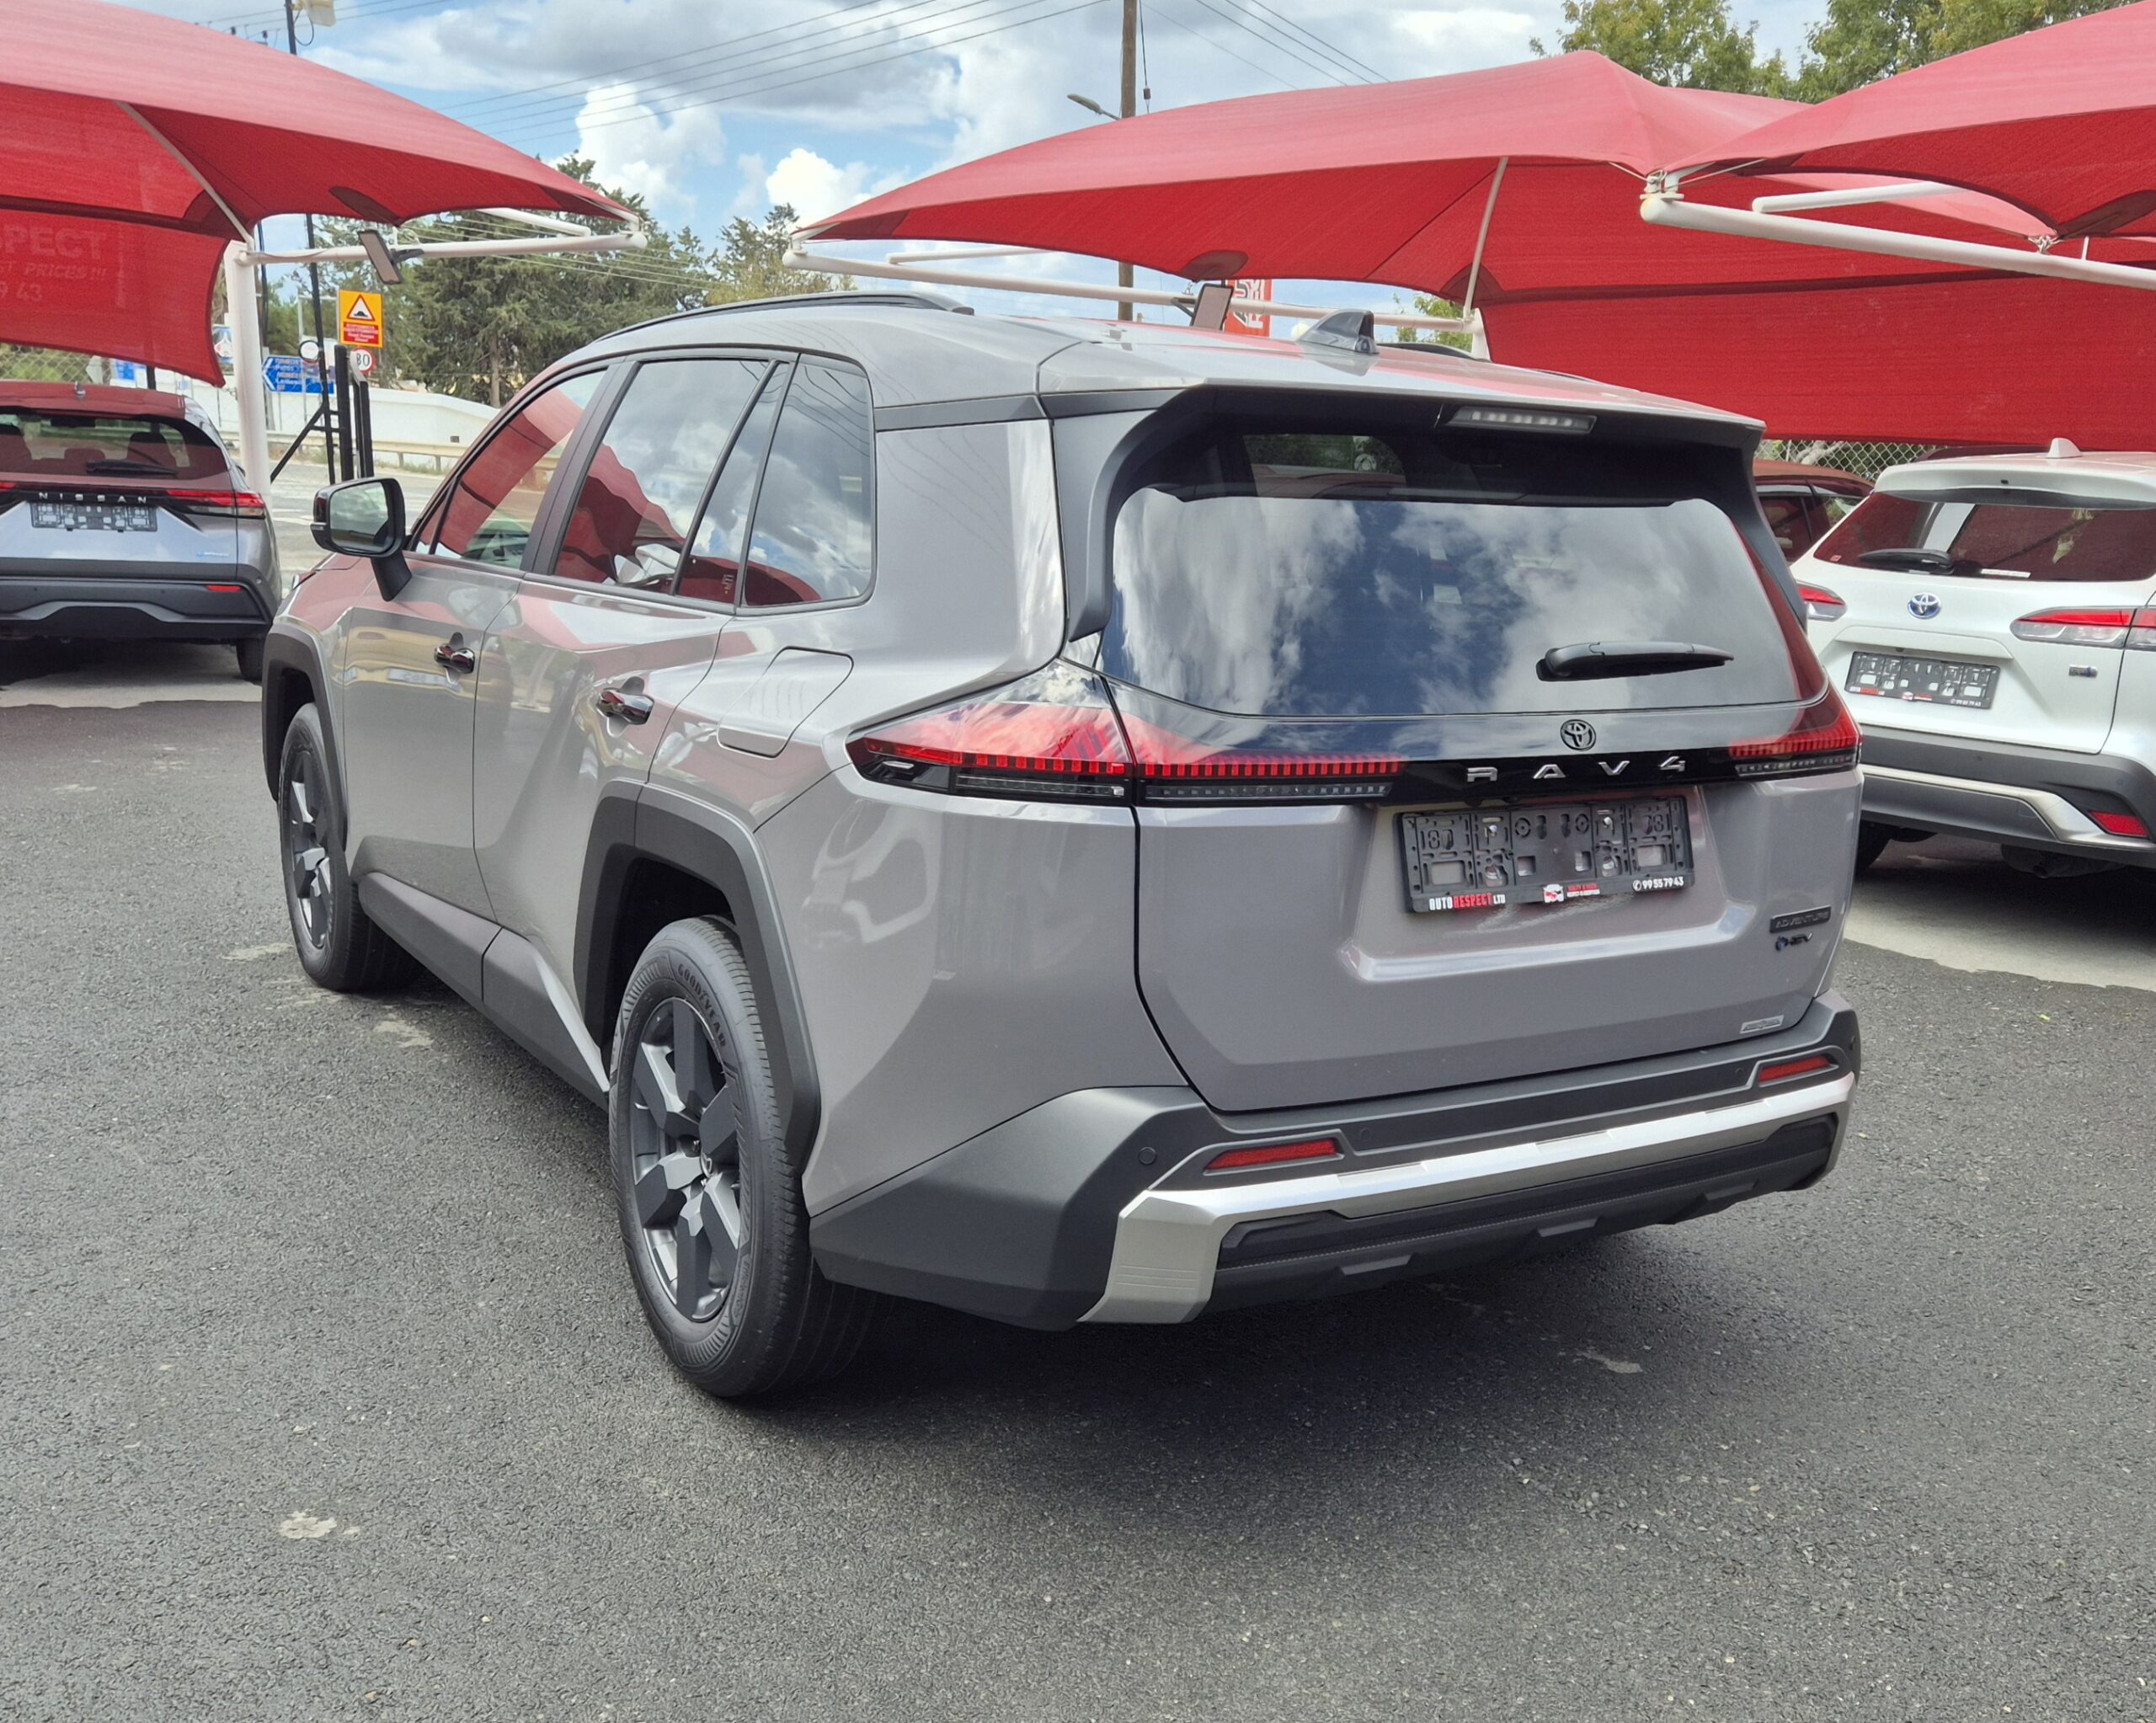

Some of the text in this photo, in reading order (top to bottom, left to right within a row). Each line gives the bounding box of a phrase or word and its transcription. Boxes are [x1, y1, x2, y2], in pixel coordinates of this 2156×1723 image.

[0, 224, 107, 259] PECT
[16, 281, 43, 302] 43
[39, 492, 147, 504] NISSAN
[1467, 755, 1686, 782] RAV4
[1493, 894, 1506, 904] LTD
[1775, 910, 1829, 929] ADVENTURE
[678, 963, 726, 1046] GOODYEAR
